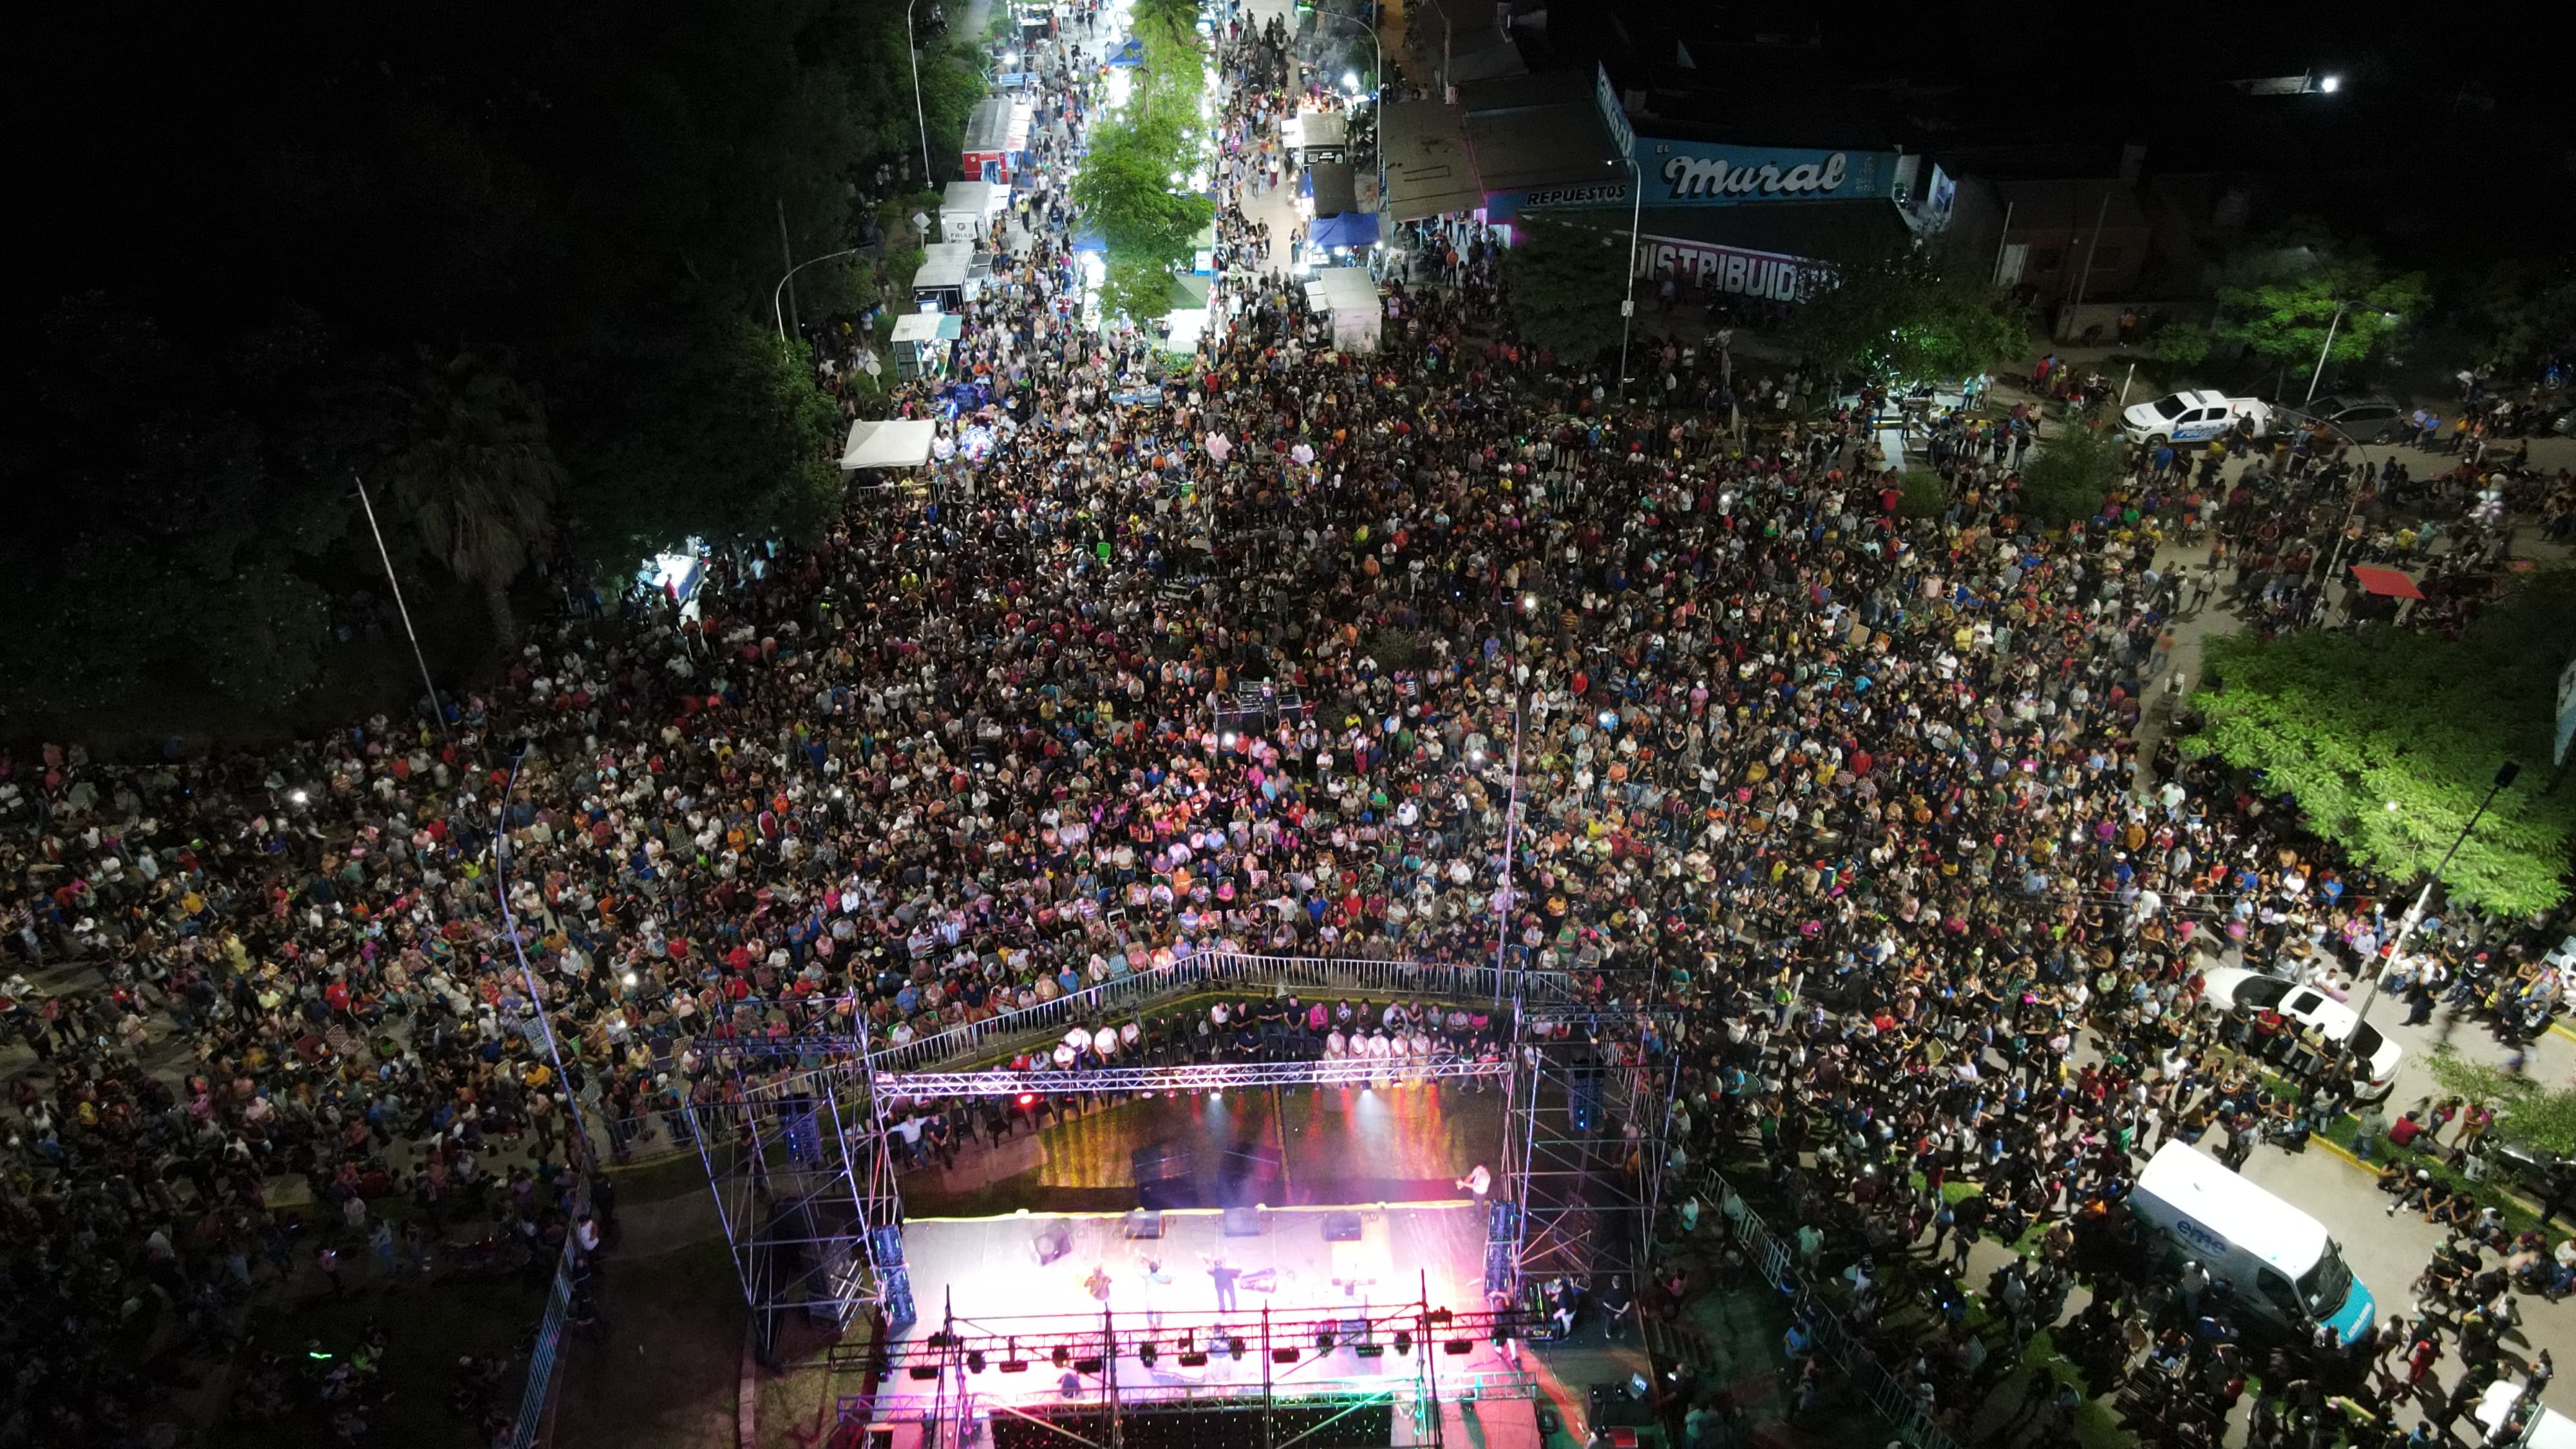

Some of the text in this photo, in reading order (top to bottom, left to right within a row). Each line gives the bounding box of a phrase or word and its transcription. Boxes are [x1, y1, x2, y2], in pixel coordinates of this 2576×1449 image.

[1655, 144, 1670, 154] EL
[1664, 153, 1847, 197] Mural
[1526, 184, 1627, 206] REPUESTOS
